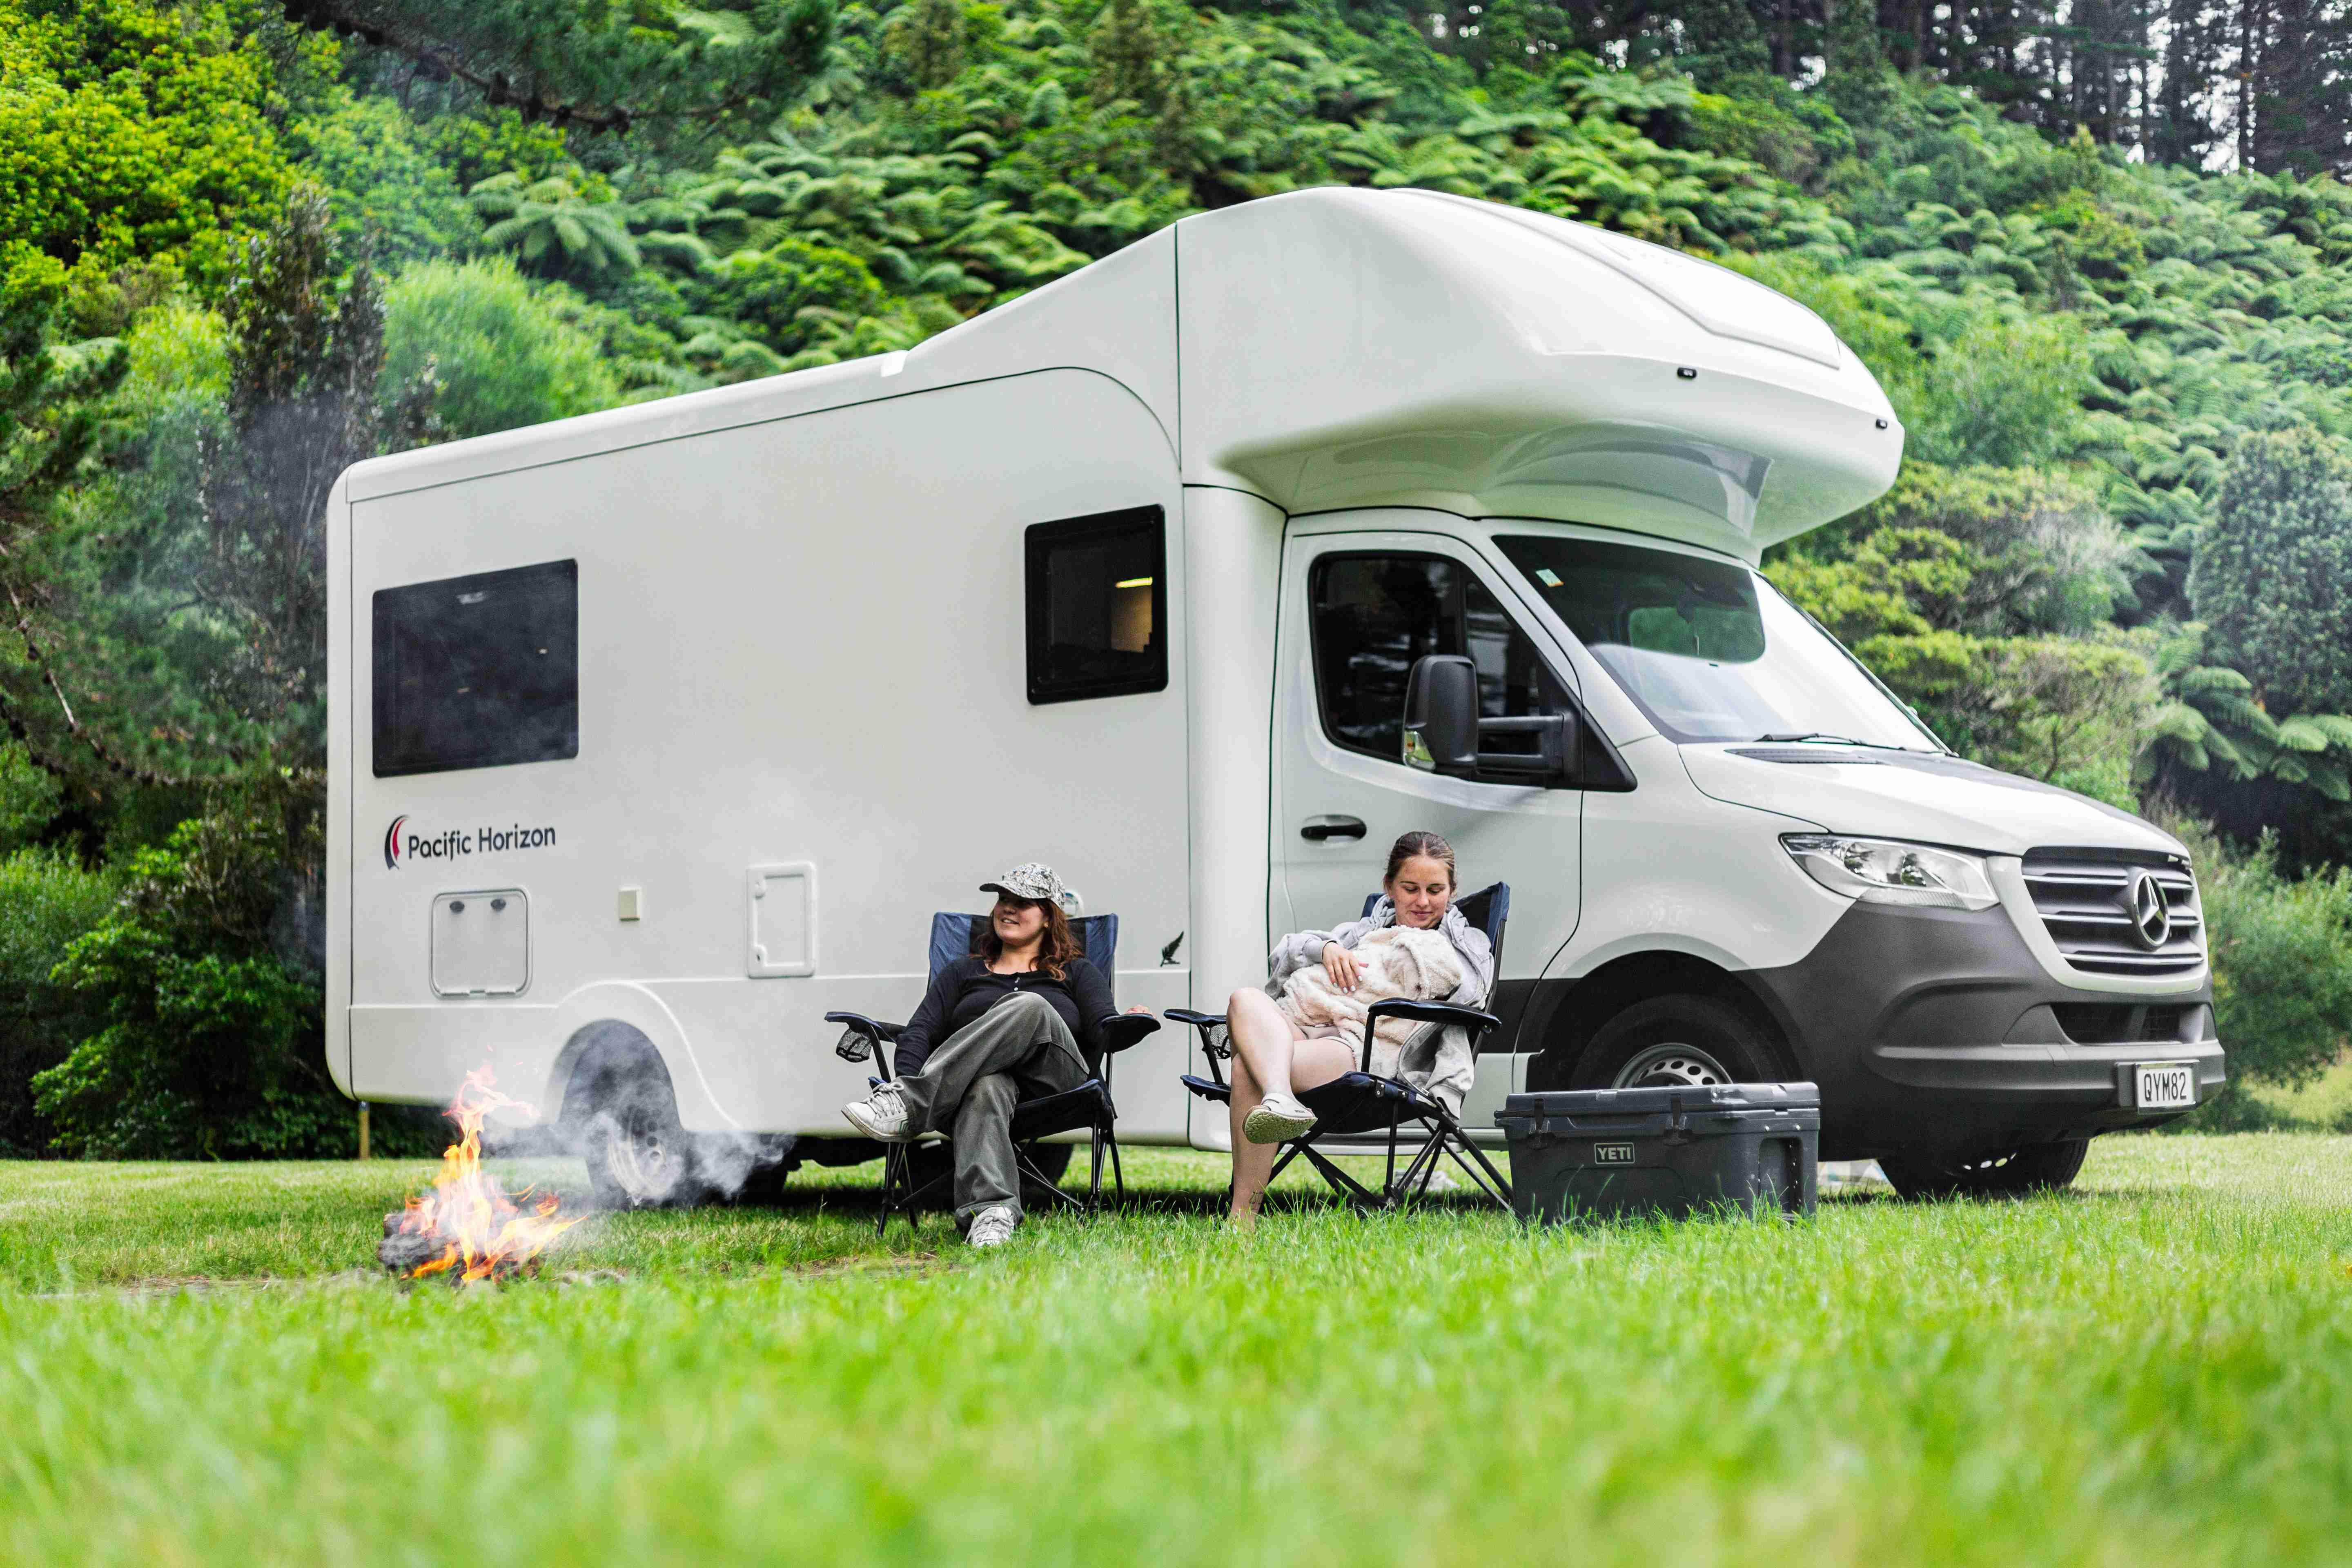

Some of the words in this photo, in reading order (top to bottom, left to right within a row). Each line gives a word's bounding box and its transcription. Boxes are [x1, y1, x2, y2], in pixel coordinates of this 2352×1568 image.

[408, 830, 471, 862] Pacific
[479, 823, 556, 852] Horizon
[2144, 1071, 2187, 1102] QYM82
[1597, 1147, 1631, 1160] YETI
